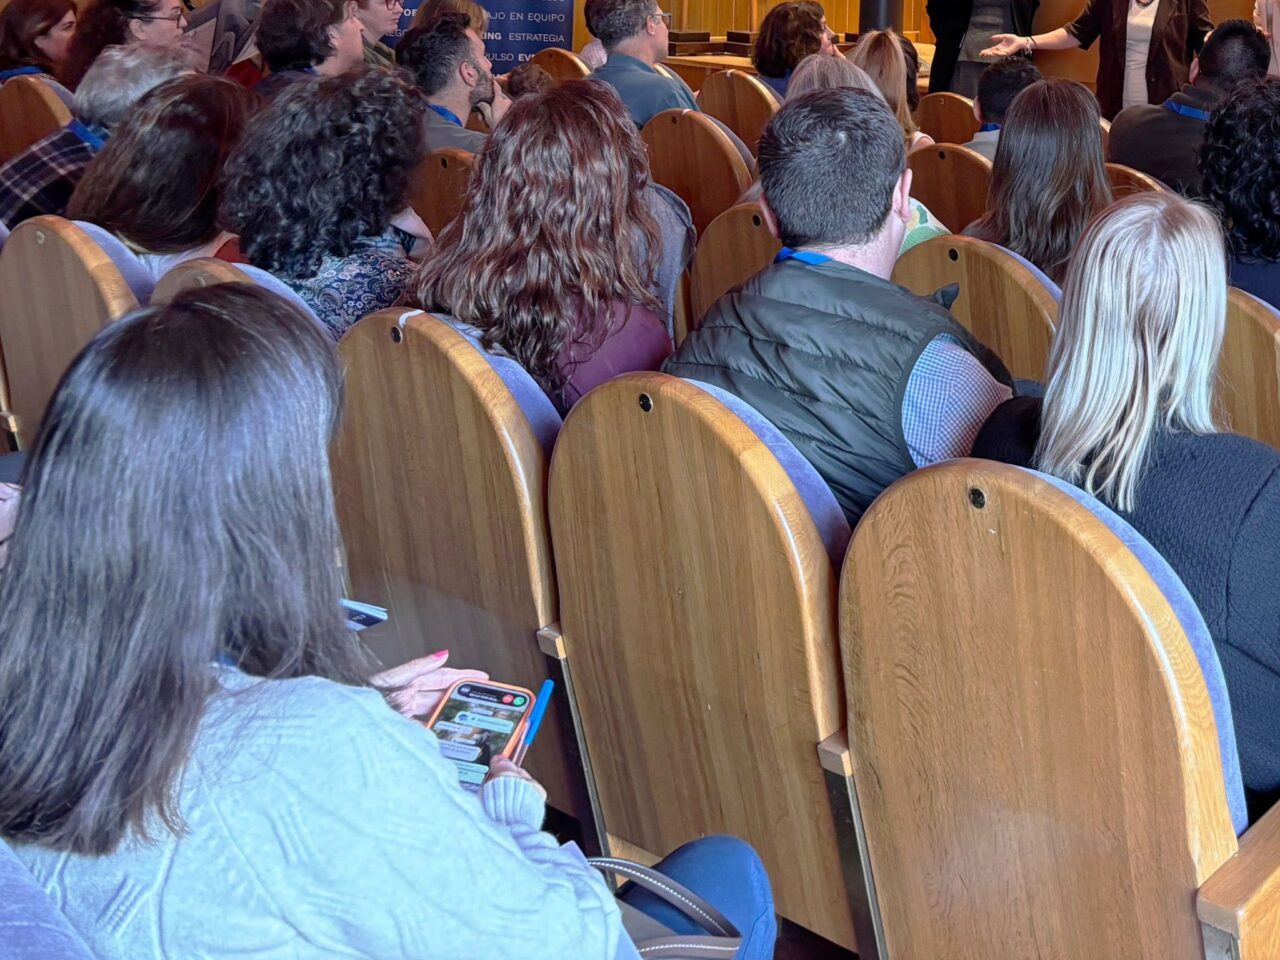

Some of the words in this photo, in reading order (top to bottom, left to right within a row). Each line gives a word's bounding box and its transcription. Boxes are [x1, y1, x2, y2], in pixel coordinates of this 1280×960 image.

[510, 12, 524, 21] EN
[528, 13, 565, 23] EQUIPO
[509, 33, 565, 43] ESTRATEGIA
